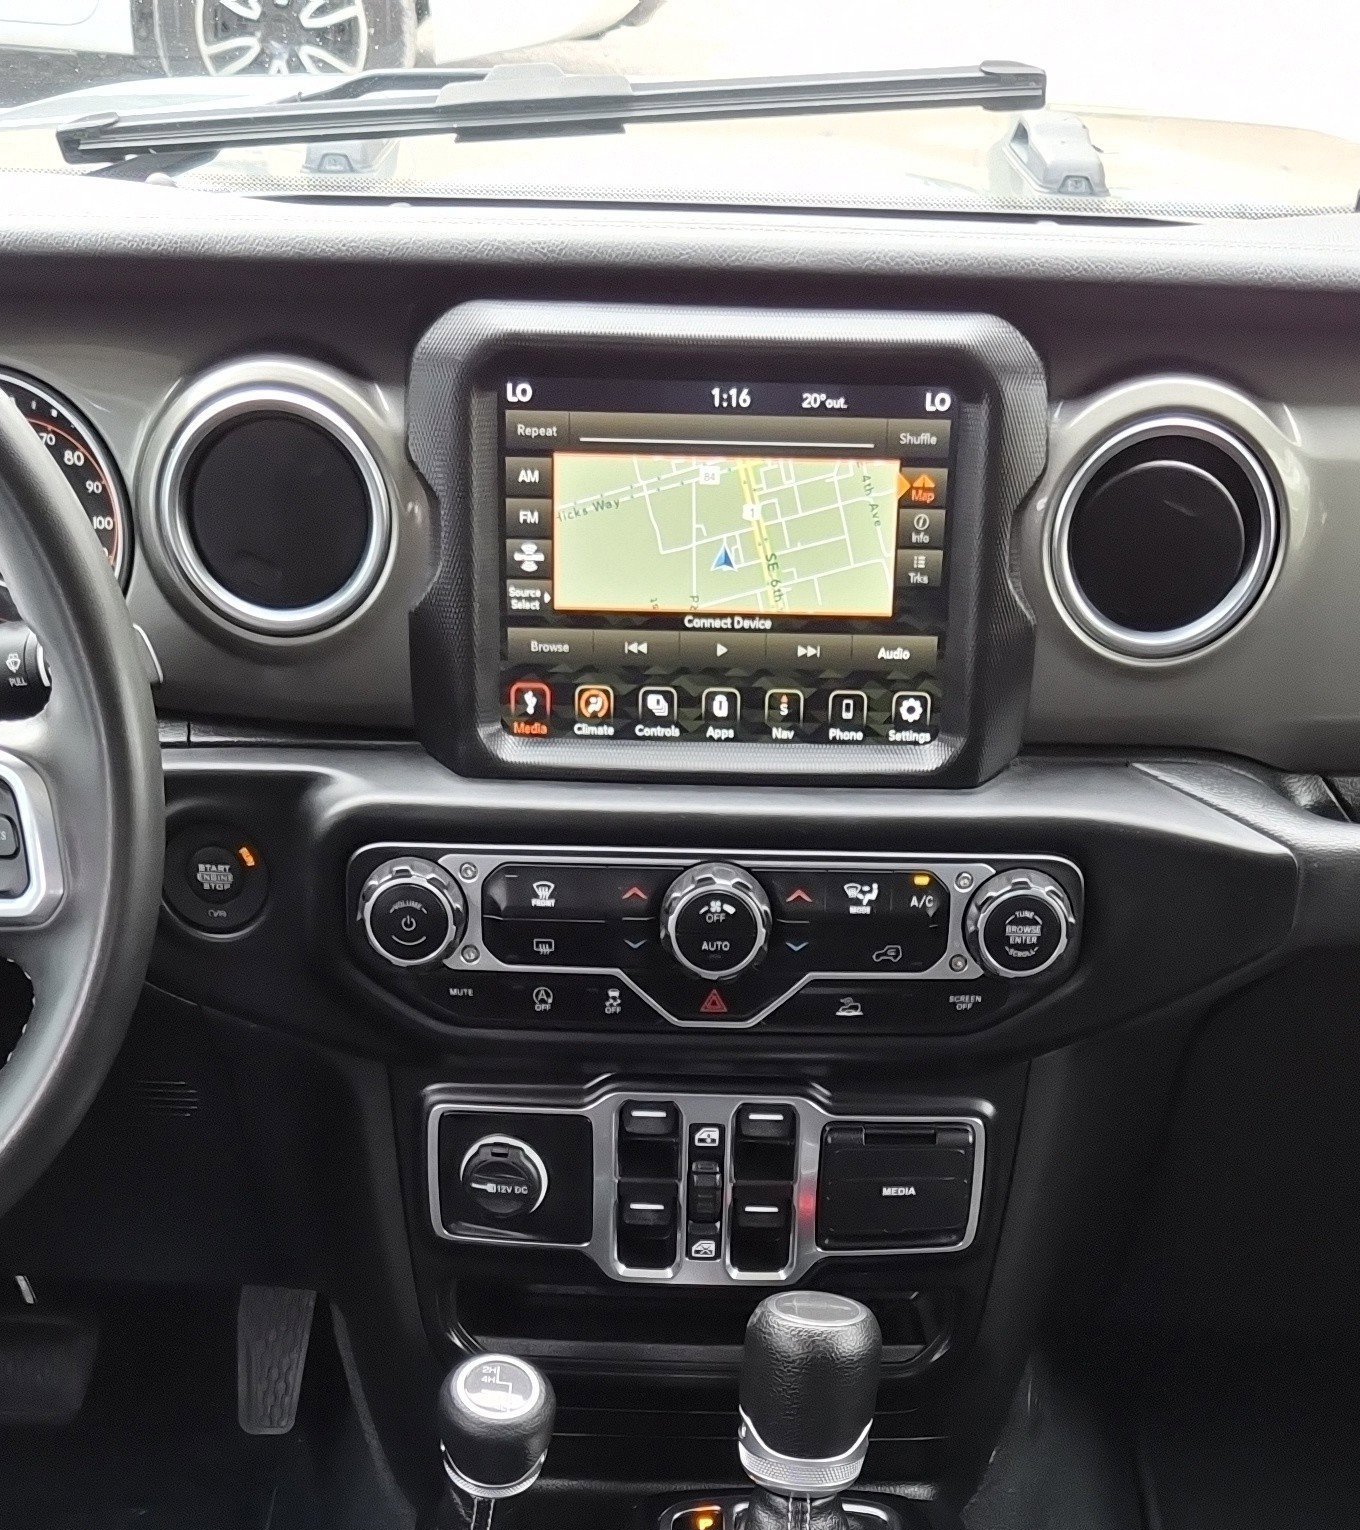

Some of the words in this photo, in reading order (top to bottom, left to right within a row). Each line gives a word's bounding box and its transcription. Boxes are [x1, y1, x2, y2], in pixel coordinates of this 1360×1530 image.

[506, 382, 533, 402] LO
[711, 387, 752, 408] 1:16
[925, 392, 952, 412] LO
[517, 424, 558, 438] Repeat
[39, 433, 55, 446] 70
[899, 432, 938, 446] Shuffle
[64, 450, 85, 466] 80
[518, 469, 540, 484] AM
[86, 481, 102, 494] 90
[862, 475, 874, 496] 4th
[869, 503, 881, 527] Ave
[911, 489, 935, 504] Map
[592, 499, 620, 513] Way
[519, 509, 540, 524] FM
[93, 516, 114, 531] 100
[911, 531, 930, 545] Info
[766, 553, 780, 572] SE
[908, 572, 929, 585] Trks
[509, 586, 541, 598] Source
[771, 579, 784, 603] 6th
[511, 598, 540, 610] Select
[684, 615, 732, 629] Connect
[734, 617, 772, 630] Device
[530, 640, 570, 653] Browse
[877, 647, 911, 660] Audio
[513, 721, 548, 735] Media
[573, 723, 614, 737] Climate
[635, 724, 681, 738] Controls
[706, 726, 735, 740] Apps
[772, 727, 795, 740] Nav
[829, 728, 864, 741] Phone
[889, 729, 931, 744] Settings
[198, 863, 231, 873] START
[910, 894, 934, 908] A/C
[705, 912, 726, 924] OFF
[1014, 910, 1035, 919] TUNE
[1005, 925, 1041, 935] BROWSE
[701, 940, 731, 951] AUTO
[1009, 936, 1038, 945] ENTER
[449, 987, 474, 997] MUTE
[949, 995, 982, 1003] SCREEN
[534, 1003, 552, 1012] OFF
[605, 1006, 622, 1015] OFF
[956, 1003, 973, 1011] OFF
[496, 1184, 513, 1194] 12V
[514, 1186, 529, 1195] DC
[882, 1186, 917, 1196] MEDIA
[482, 1365, 497, 1374] 2H
[481, 1375, 496, 1383] 4H
[699, 1518, 714, 1530] P
